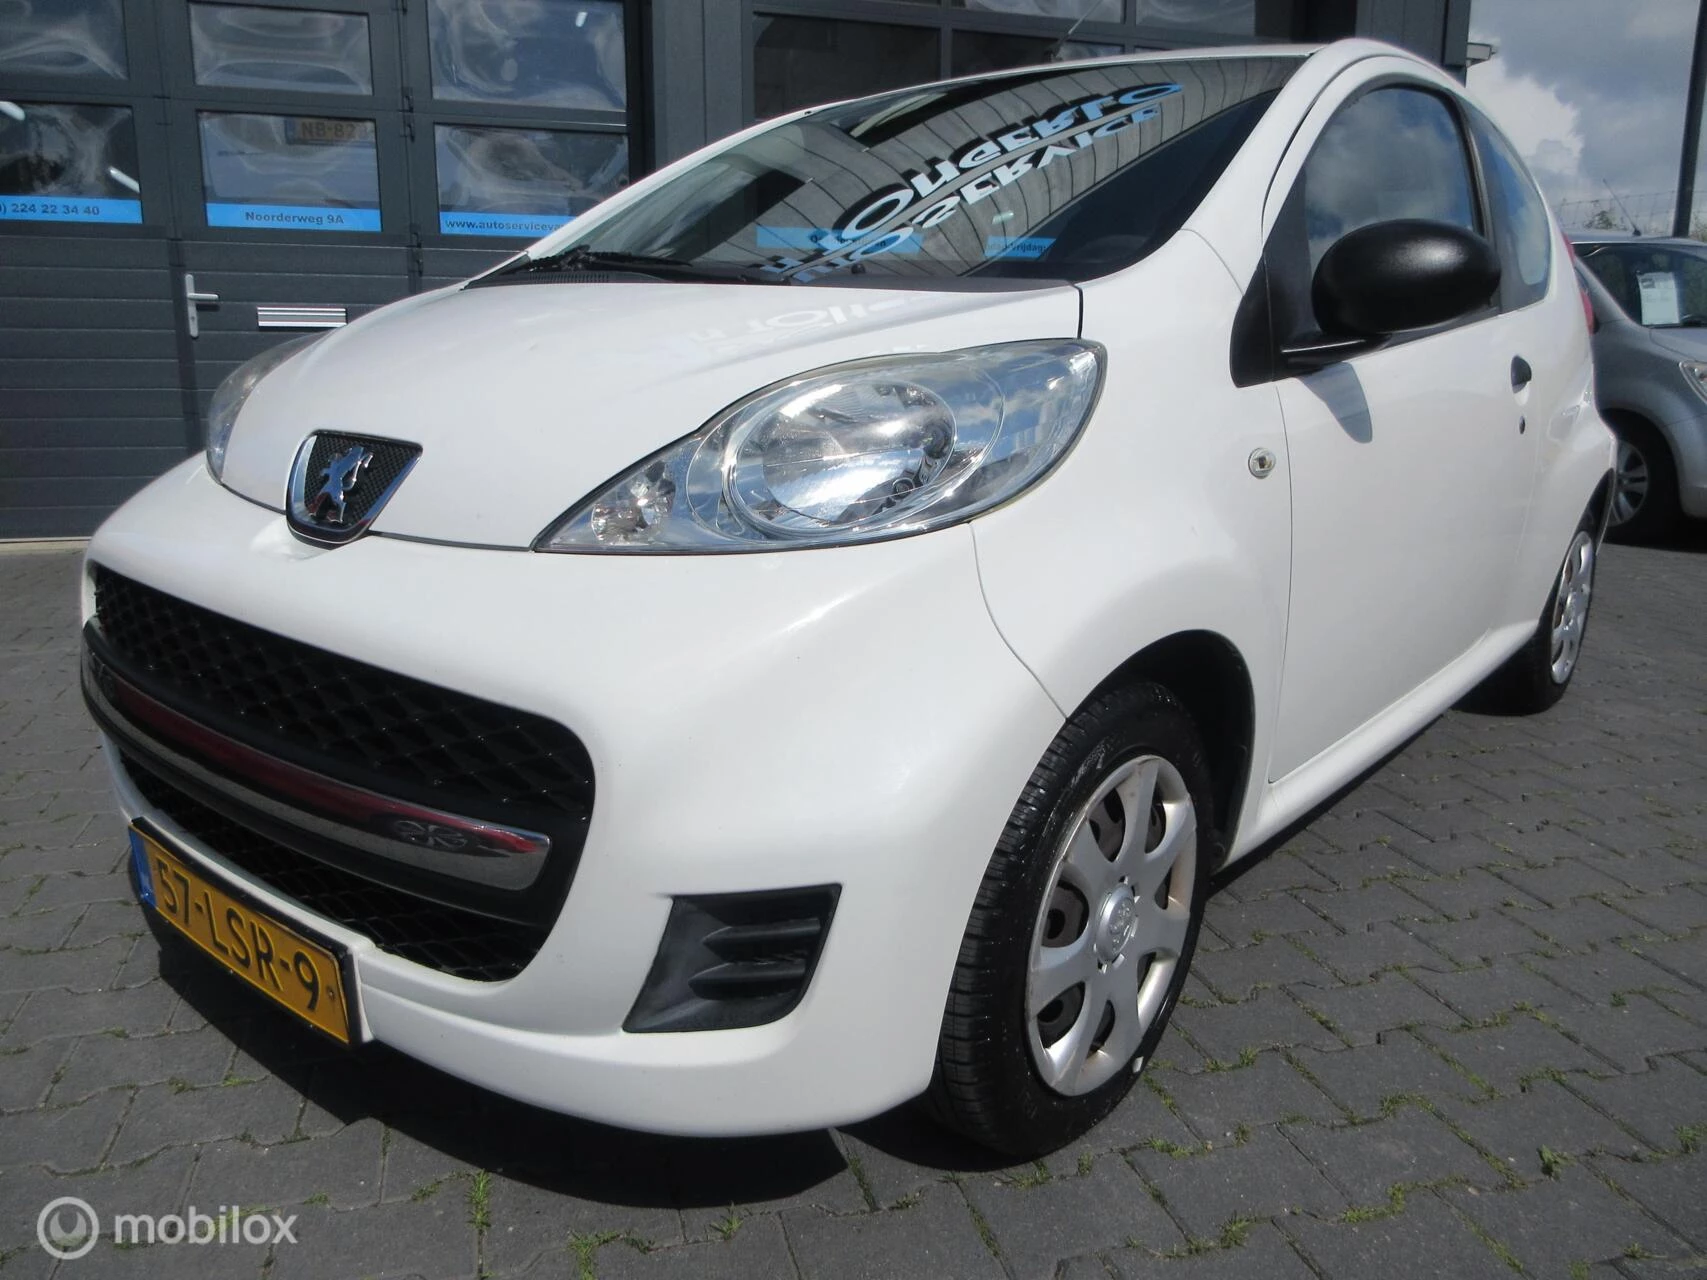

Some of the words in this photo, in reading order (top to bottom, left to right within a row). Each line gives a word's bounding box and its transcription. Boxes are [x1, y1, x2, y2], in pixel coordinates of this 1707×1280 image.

[11, 203, 36, 213] 224
[41, 204, 58, 214] 22
[63, 205, 79, 215] 34
[83, 206, 100, 216] 40
[245, 212, 323, 225] Noorderweg
[327, 214, 344, 224] 9A
[157, 855, 321, 1012] 57-LSR-9
